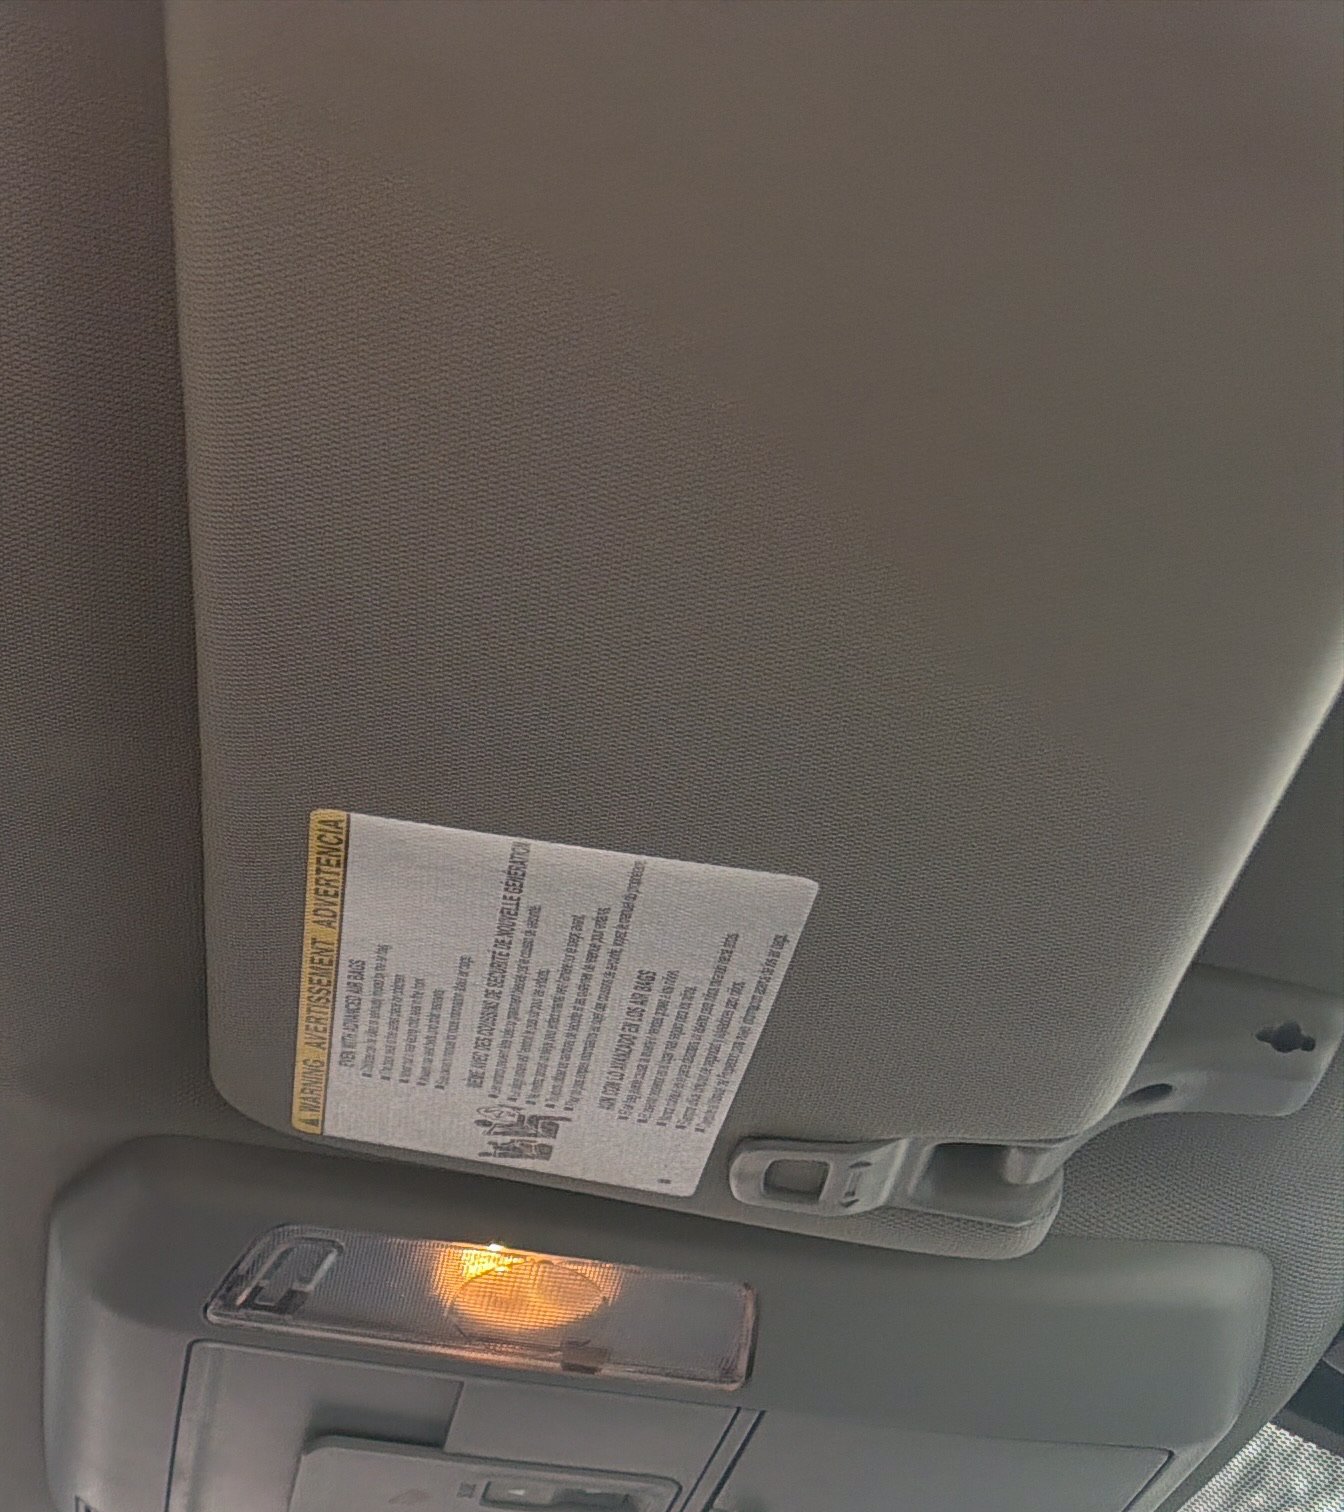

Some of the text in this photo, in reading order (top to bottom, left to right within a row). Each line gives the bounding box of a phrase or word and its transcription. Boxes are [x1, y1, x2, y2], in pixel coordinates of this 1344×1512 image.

[299, 816, 344, 1114] WARNING AVERTISSEMENT ADVERTENCIA
[346, 957, 365, 981] BAGS
[631, 968, 657, 992] BAGS
[622, 1005, 646, 1022] LOS
